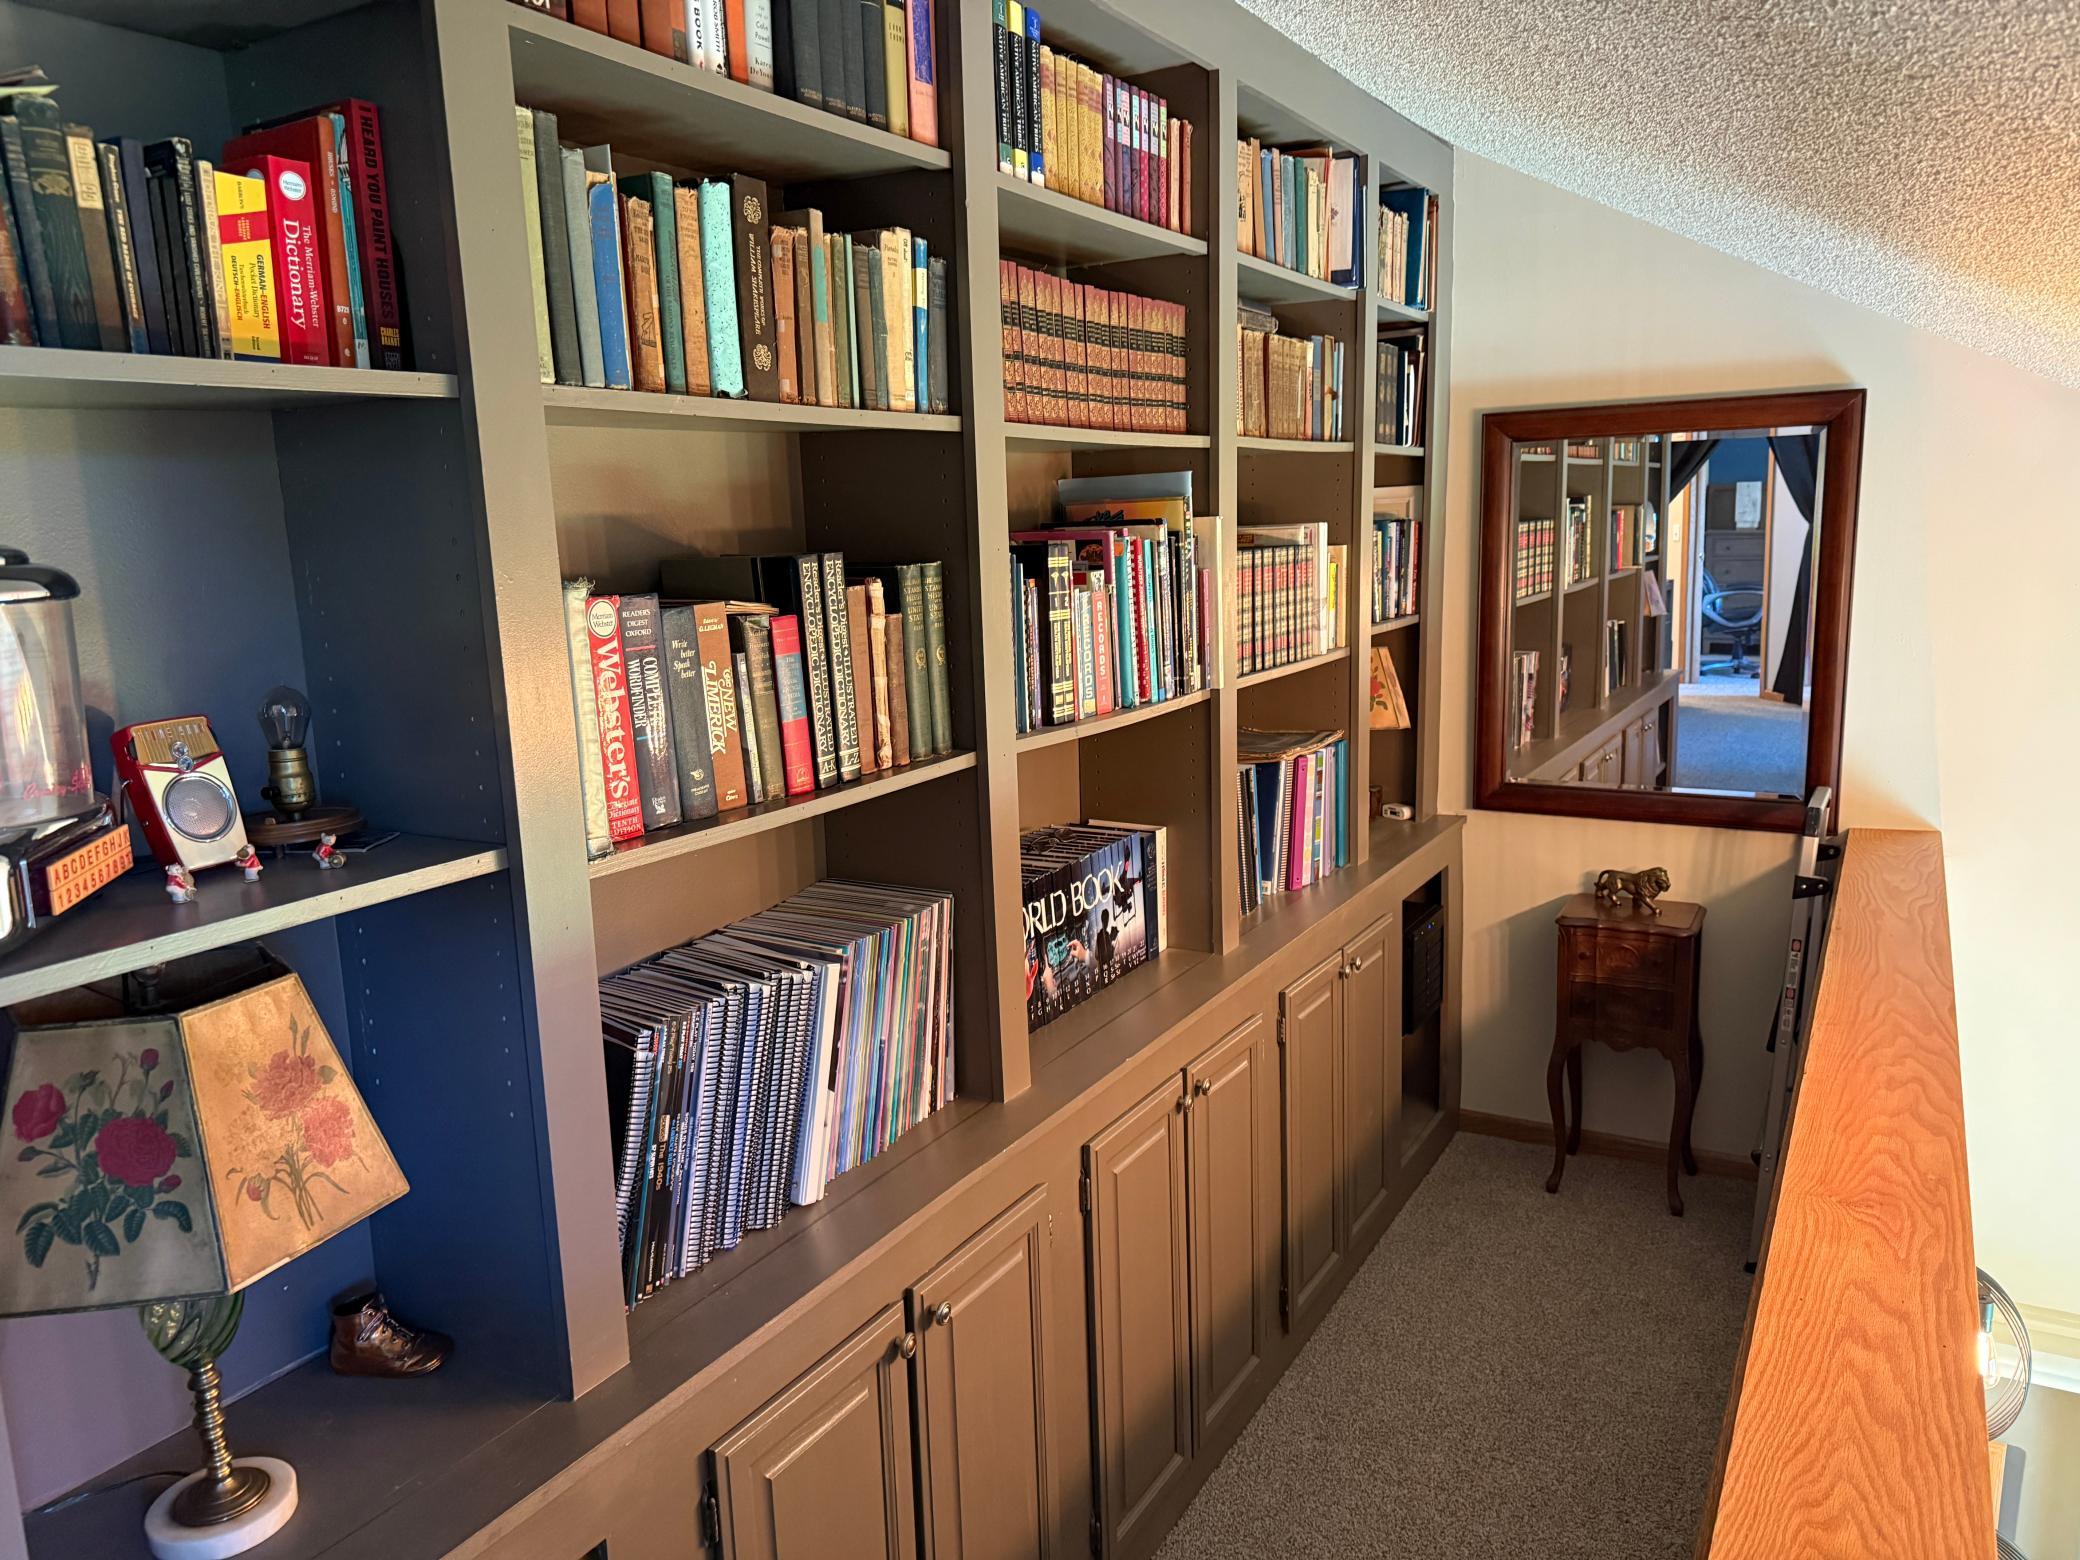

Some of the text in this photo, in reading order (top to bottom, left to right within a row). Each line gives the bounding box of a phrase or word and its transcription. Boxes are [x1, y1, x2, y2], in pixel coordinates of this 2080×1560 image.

[694, 7, 703, 50] BOOK
[360, 114, 378, 169] HEARD
[367, 172, 382, 205] YOU
[371, 207, 388, 255] PAINT
[249, 262, 260, 318] Pocket Dictionary
[283, 217, 306, 330] Dictionary
[302, 225, 320, 328] The Merriam-Webster
[376, 258, 394, 320] HOUSES
[752, 275, 761, 336] SHAKESPEARE
[625, 628, 652, 638] OXFORD
[626, 619, 649, 627] DIGEST
[672, 639, 688, 650] Write
[1096, 600, 1106, 676] RECORDS
[673, 658, 691, 672] Speak
[680, 649, 696, 659] better
[680, 670, 696, 679] better
[803, 562, 828, 753] ENCYCLOPEDIC DICTIONARY
[811, 561, 835, 752] Reader's Digest ILLUSTRATED
[825, 559, 851, 746] ENCYCLOPEDIC DICTIONARY
[835, 559, 859, 745] Reader's Digest ILLUSTRATED
[1083, 614, 1093, 698] RECORDS
[596, 636, 631, 799] Webster's
[627, 658, 648, 729] WORDFINDER
[704, 660, 726, 755] LIMERICK
[718, 678, 738, 733] NEW
[821, 759, 836, 773] A-K
[843, 752, 860, 766] L-Z
[612, 817, 638, 829] TENTH
[1023, 890, 1067, 939] ORLD
[1070, 861, 1125, 917] BOOK
[656, 1142, 666, 1191] The 1940s
